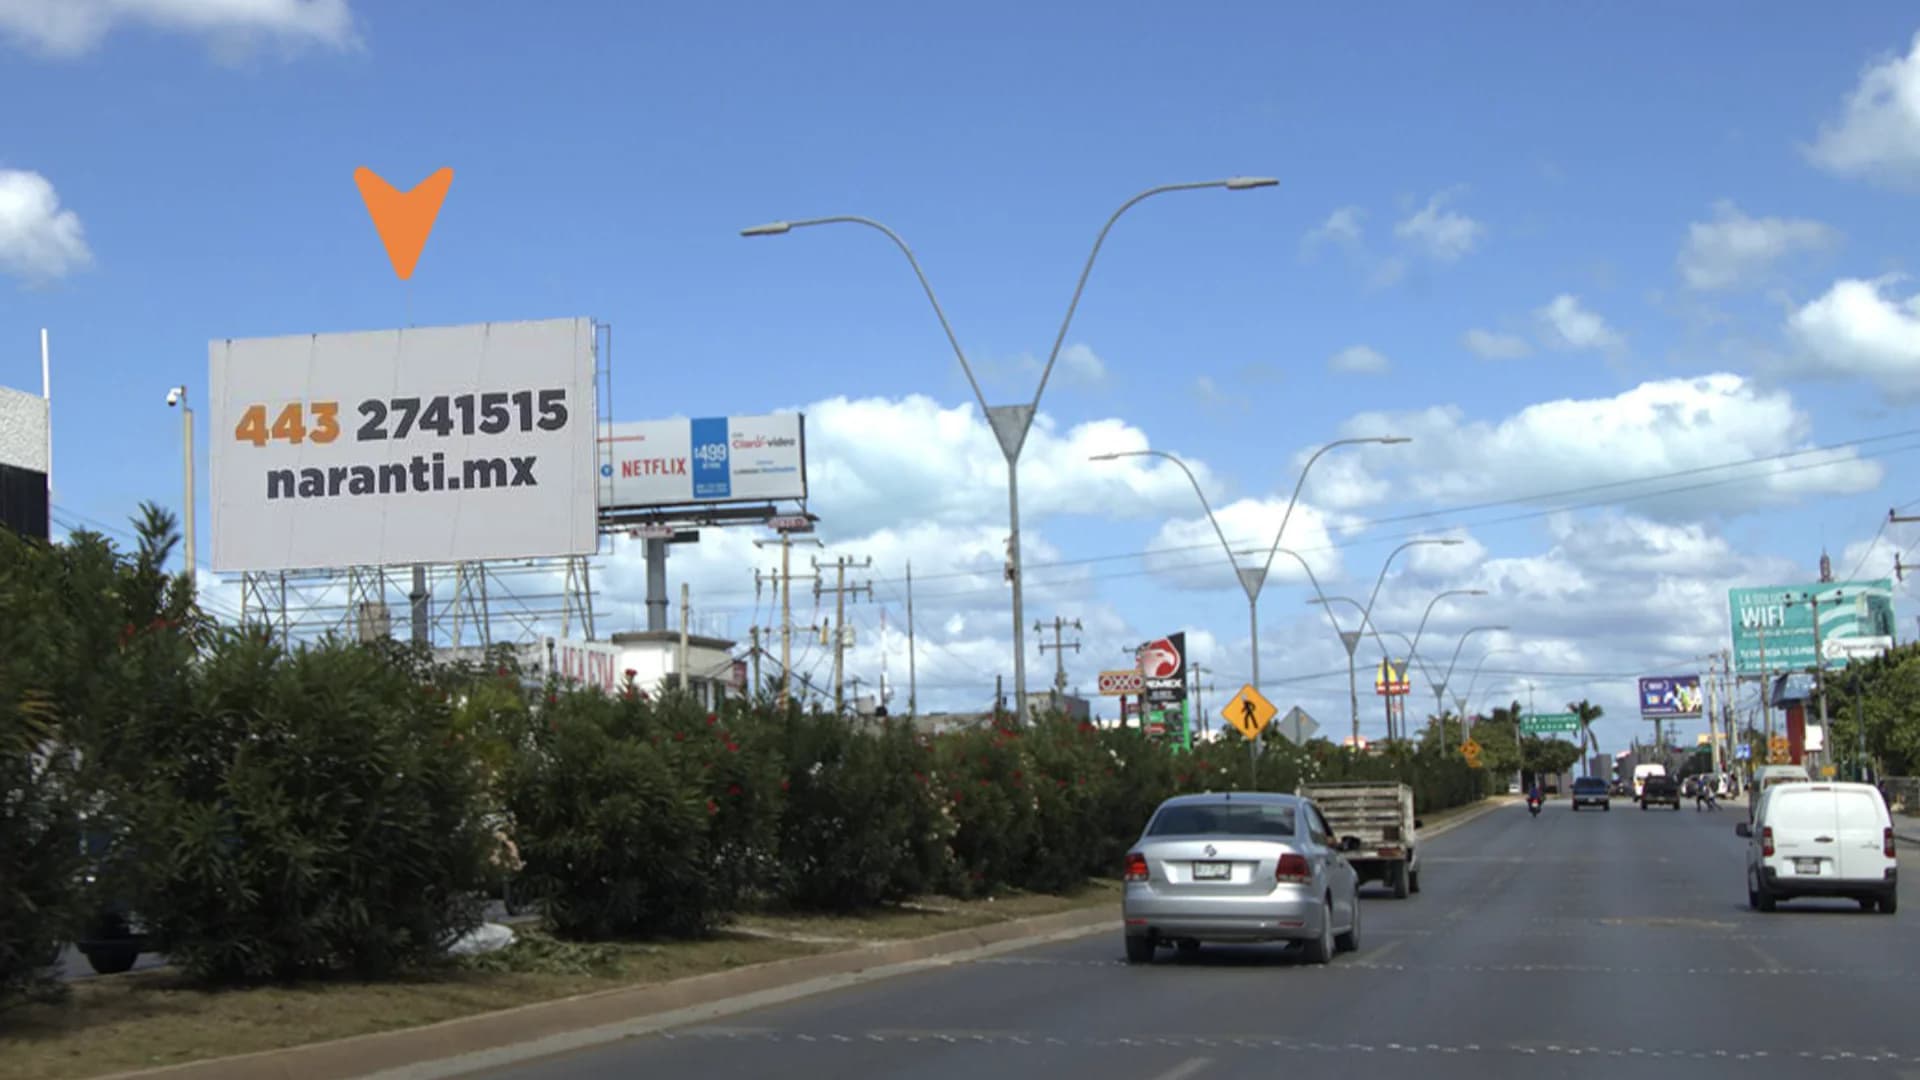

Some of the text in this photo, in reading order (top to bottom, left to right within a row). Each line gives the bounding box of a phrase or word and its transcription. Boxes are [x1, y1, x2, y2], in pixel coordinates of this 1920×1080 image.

[236, 389, 568, 446] 443 2741515
[268, 453, 537, 499] naranti.mx
[622, 457, 686, 478] NETFLIX
[1740, 605, 1785, 627] WIFI
[1101, 674, 1143, 691] OXXO
